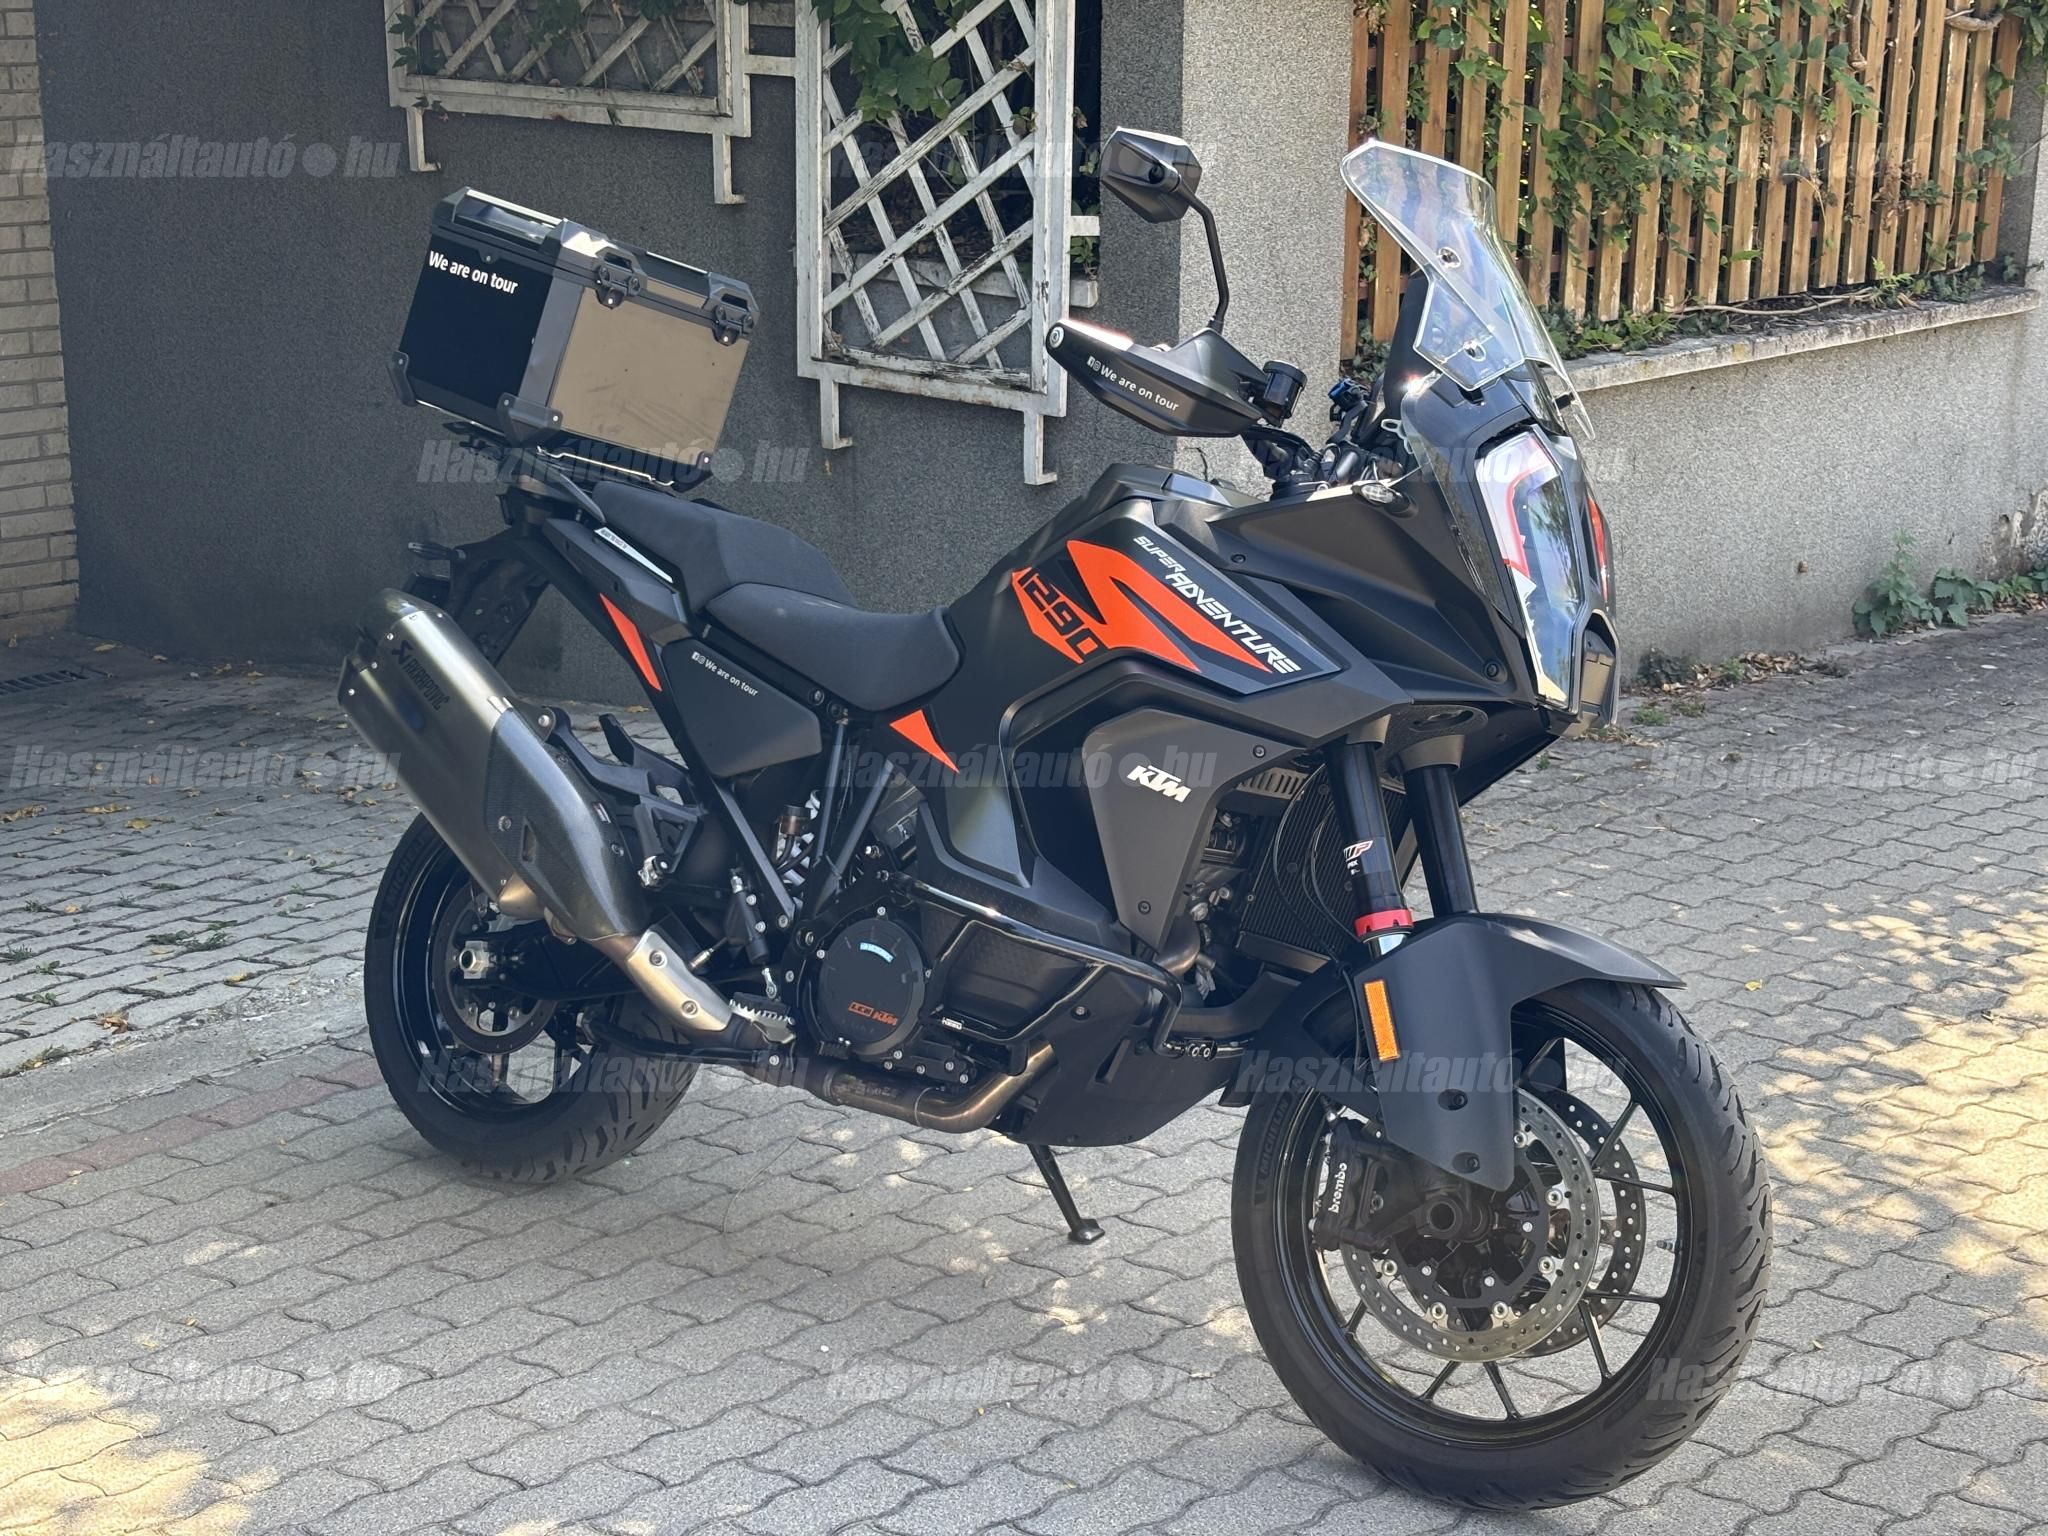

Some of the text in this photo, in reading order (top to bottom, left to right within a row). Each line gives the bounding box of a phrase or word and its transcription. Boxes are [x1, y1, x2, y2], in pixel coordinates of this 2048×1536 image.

[429, 250, 518, 294] We are on tour
[1100, 364, 1180, 411] We are on tour
[1133, 535, 1302, 674] SUPER ADVENTURE
[705, 659, 759, 697] We are on tour
[1126, 765, 1192, 803] KTM
[1328, 1162, 1348, 1214] brembo
